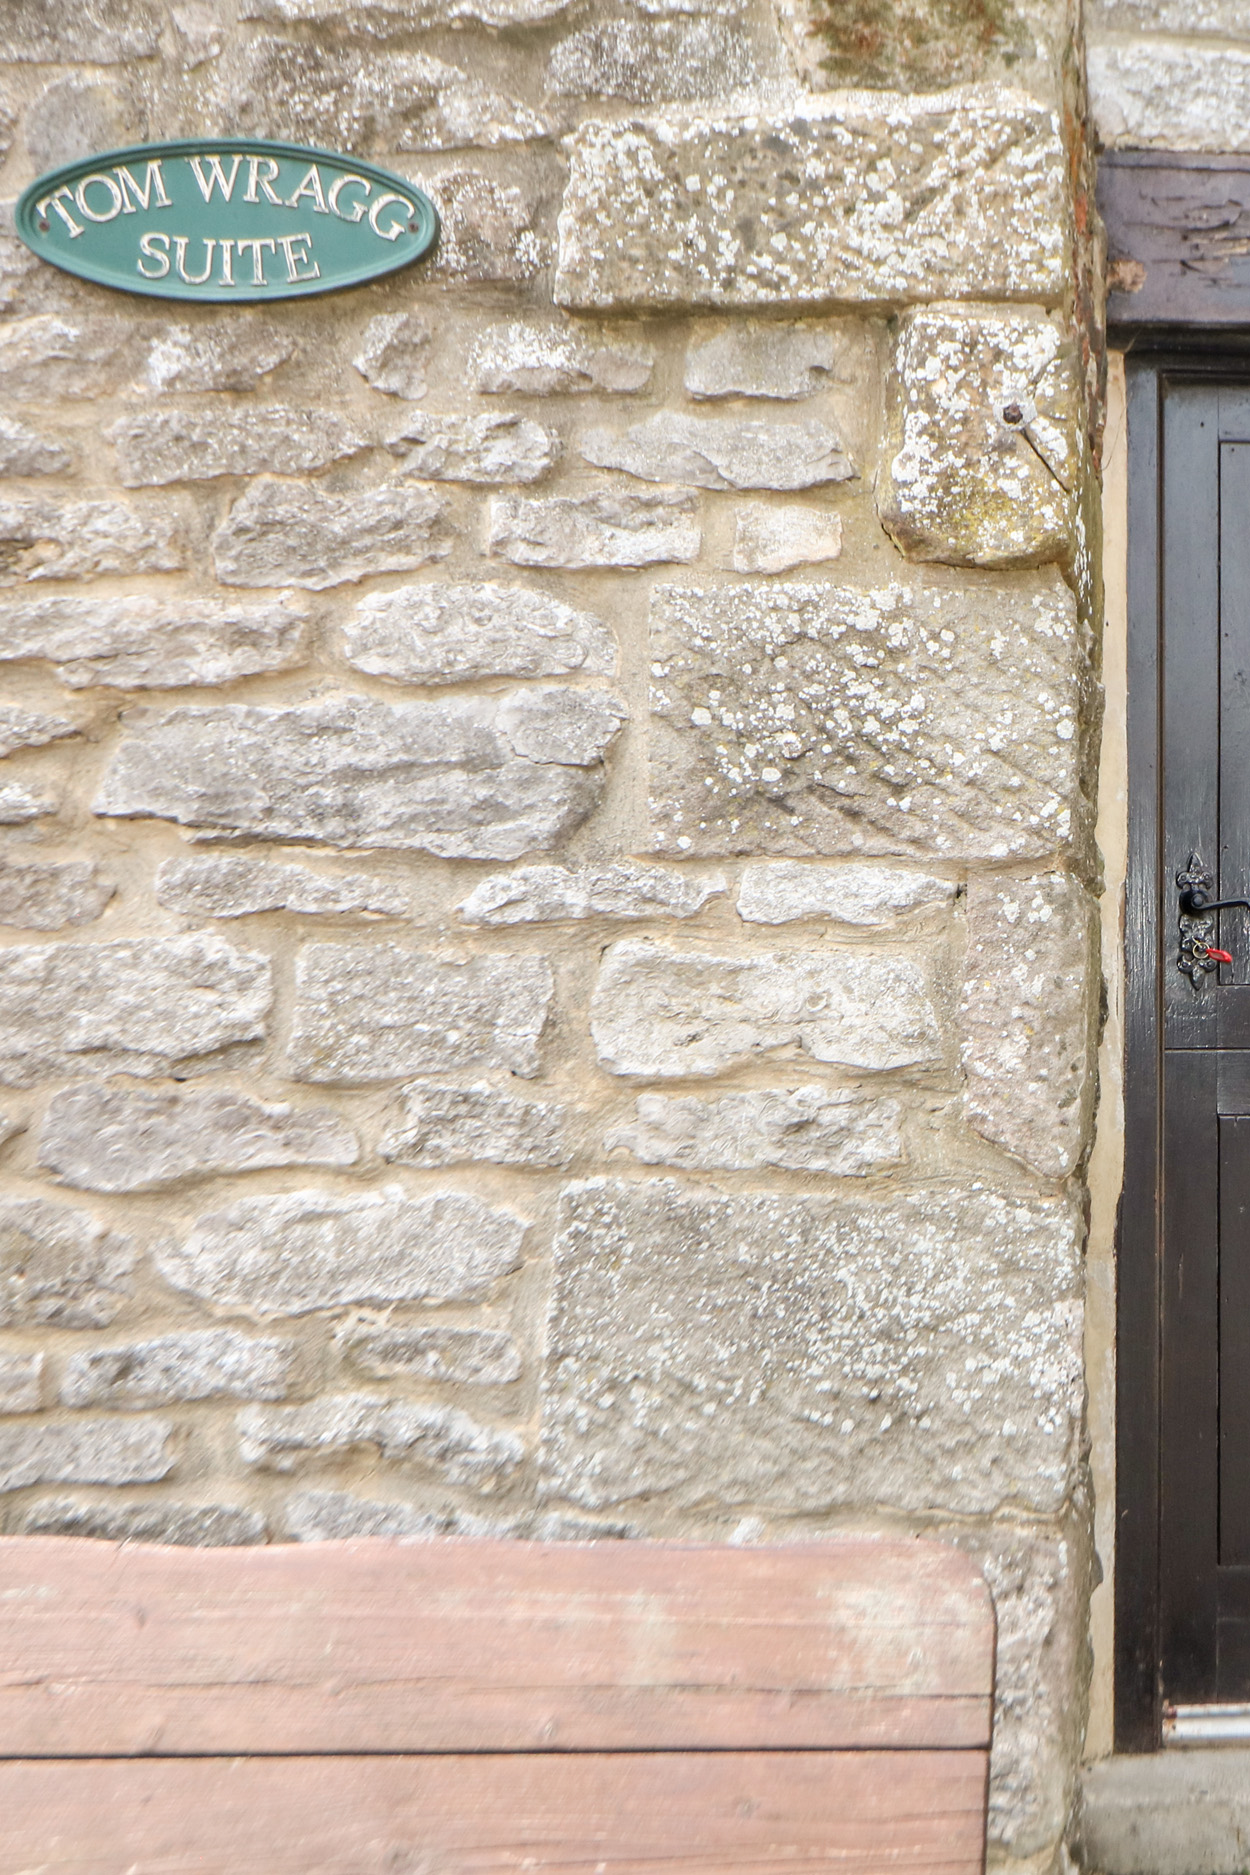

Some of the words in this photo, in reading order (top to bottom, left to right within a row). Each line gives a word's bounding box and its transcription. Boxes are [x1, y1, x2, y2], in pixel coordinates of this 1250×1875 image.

[35, 159, 173, 239] TOM
[185, 154, 415, 242] WRAGG
[137, 232, 320, 287] SUITE
